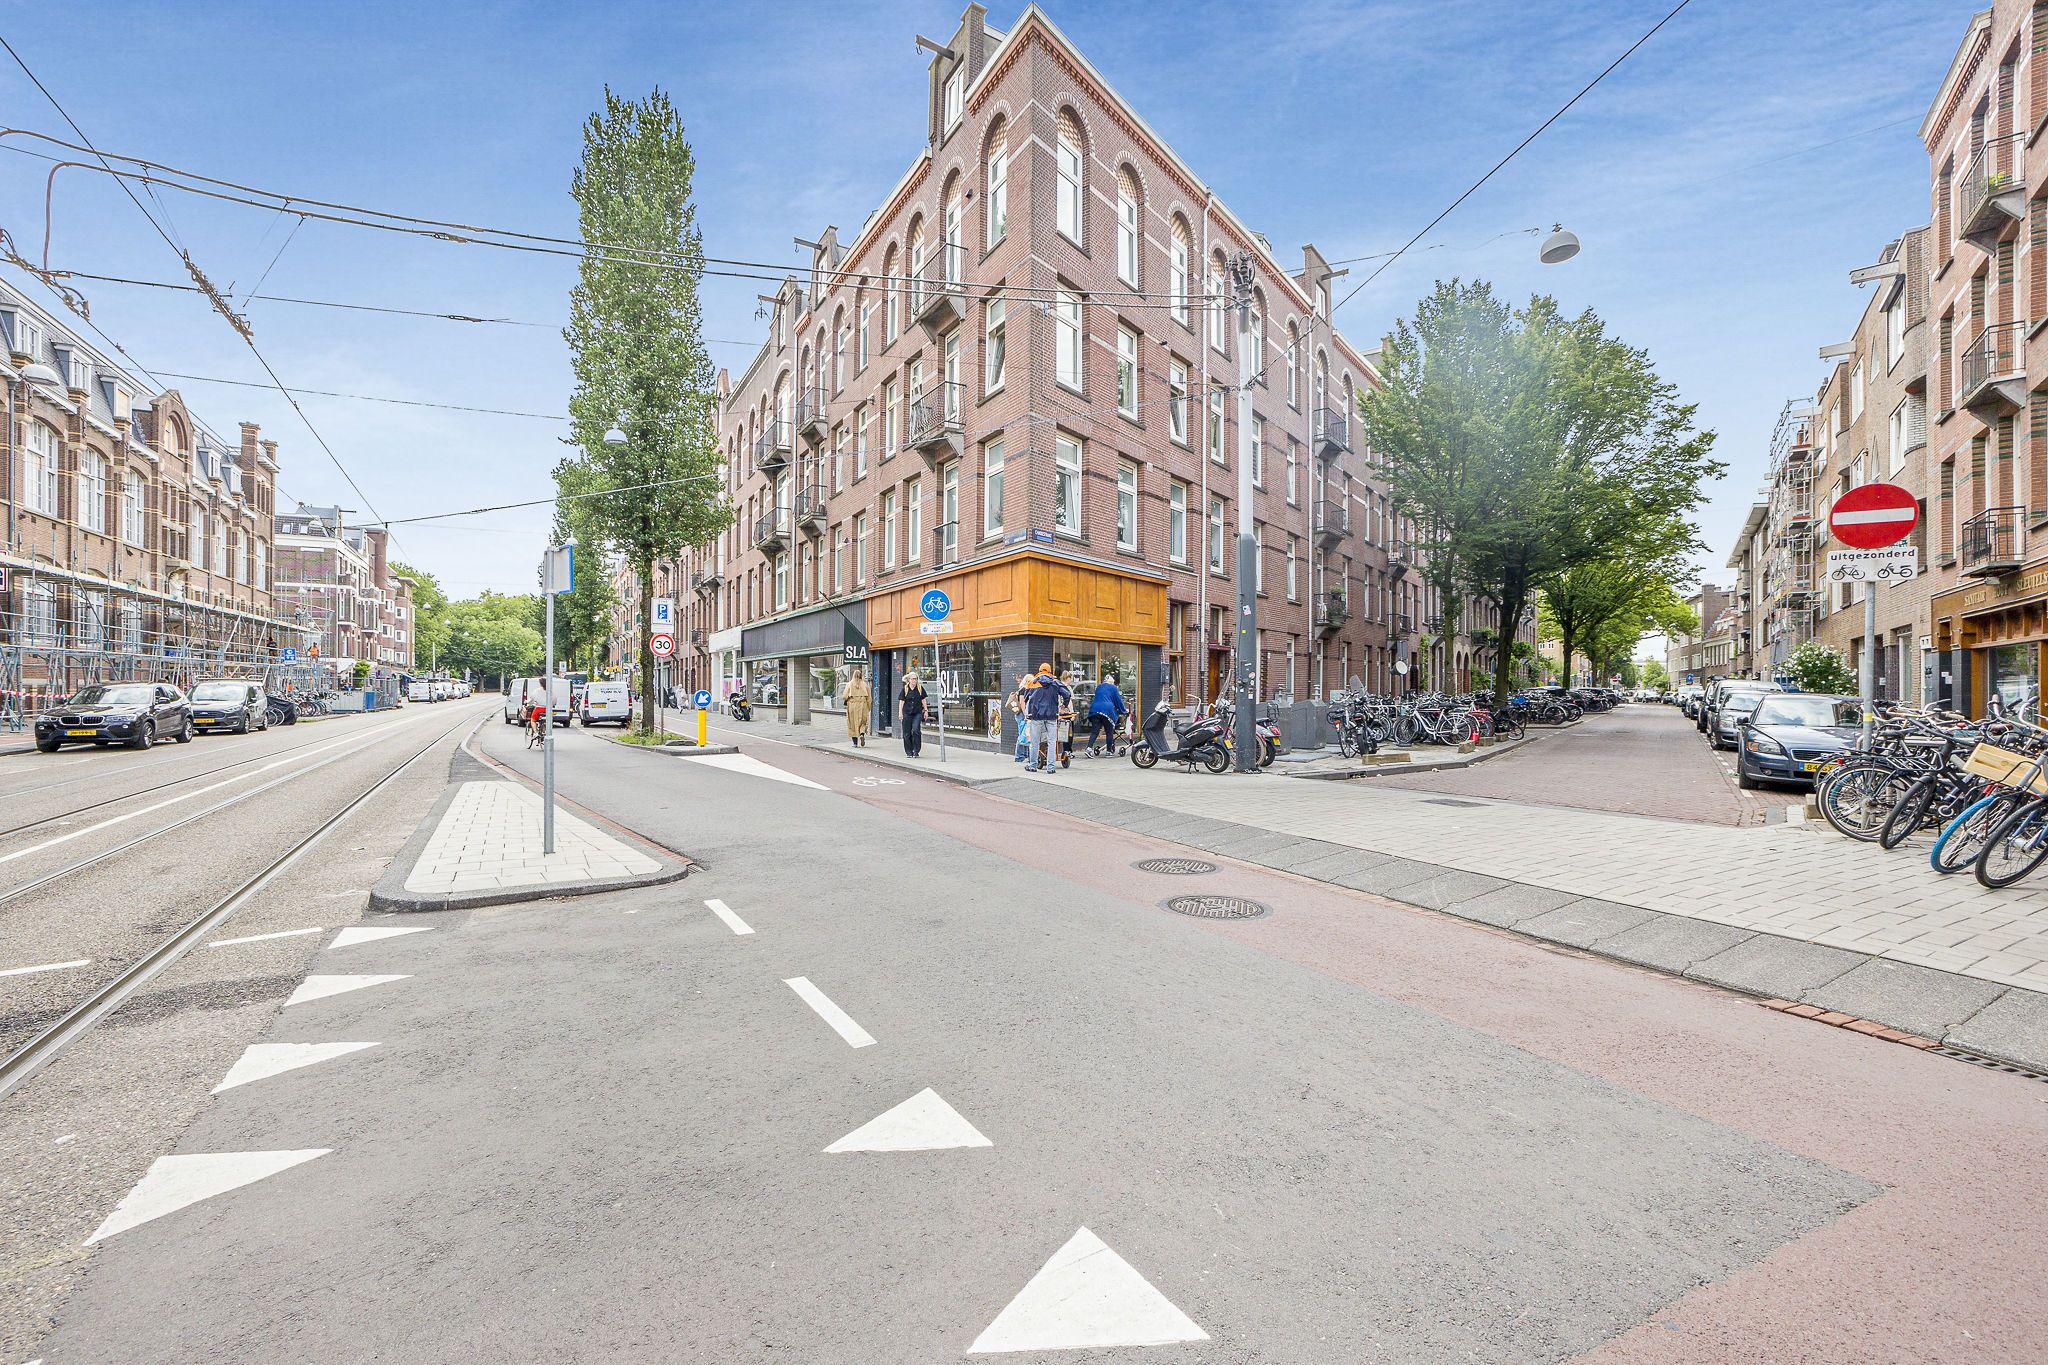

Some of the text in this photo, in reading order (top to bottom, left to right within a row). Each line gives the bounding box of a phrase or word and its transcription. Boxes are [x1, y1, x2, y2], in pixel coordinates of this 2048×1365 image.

[1830, 549, 1915, 561] uitgezonderd
[655, 640, 671, 650] 30
[845, 645, 867, 659] SLA
[940, 670, 960, 698] SLA
